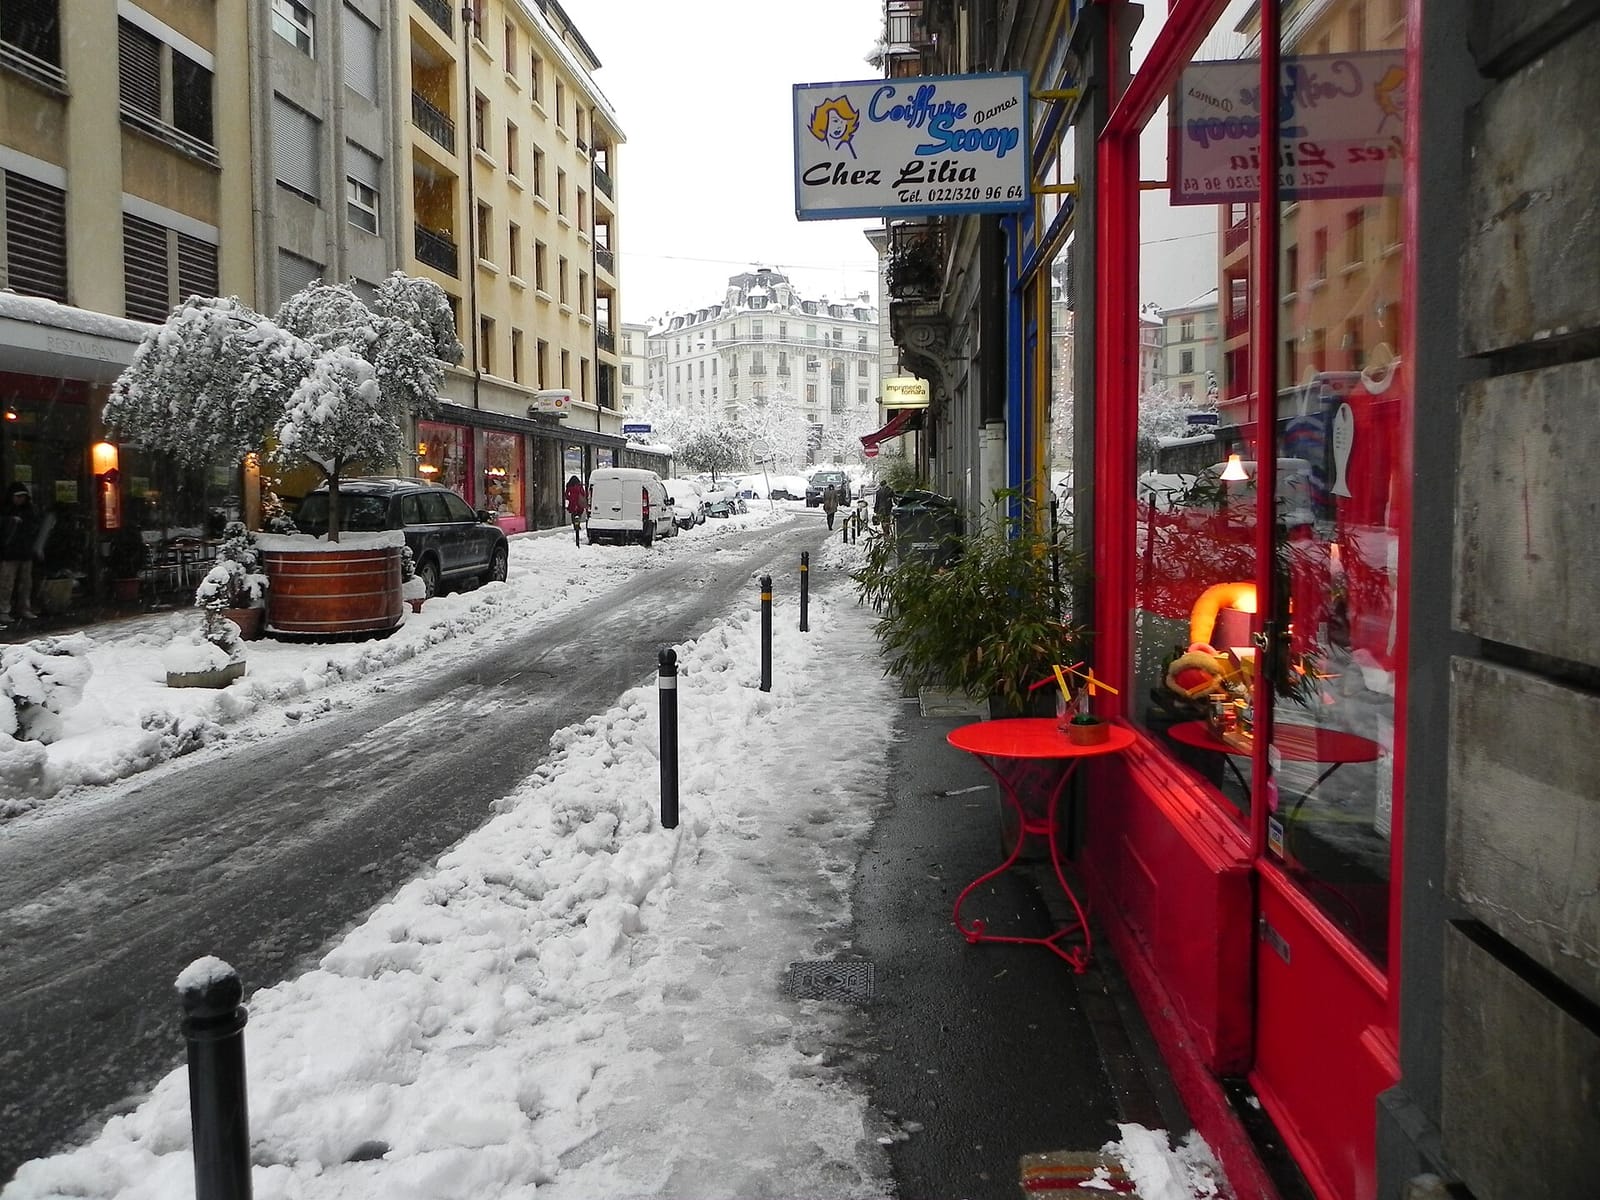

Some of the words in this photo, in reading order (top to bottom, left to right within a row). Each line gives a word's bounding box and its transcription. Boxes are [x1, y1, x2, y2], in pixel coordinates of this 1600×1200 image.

[868, 84, 968, 129] Coiffure
[973, 96, 1019, 125] Dames
[915, 113, 1019, 158] Scoop
[802, 161, 881, 186] Chez
[892, 159, 977, 189] Lilia
[897, 189, 923, 203] Tél.
[928, 187, 980, 202] 022/320
[985, 185, 1002, 200] 96
[1007, 185, 1023, 199] 64
